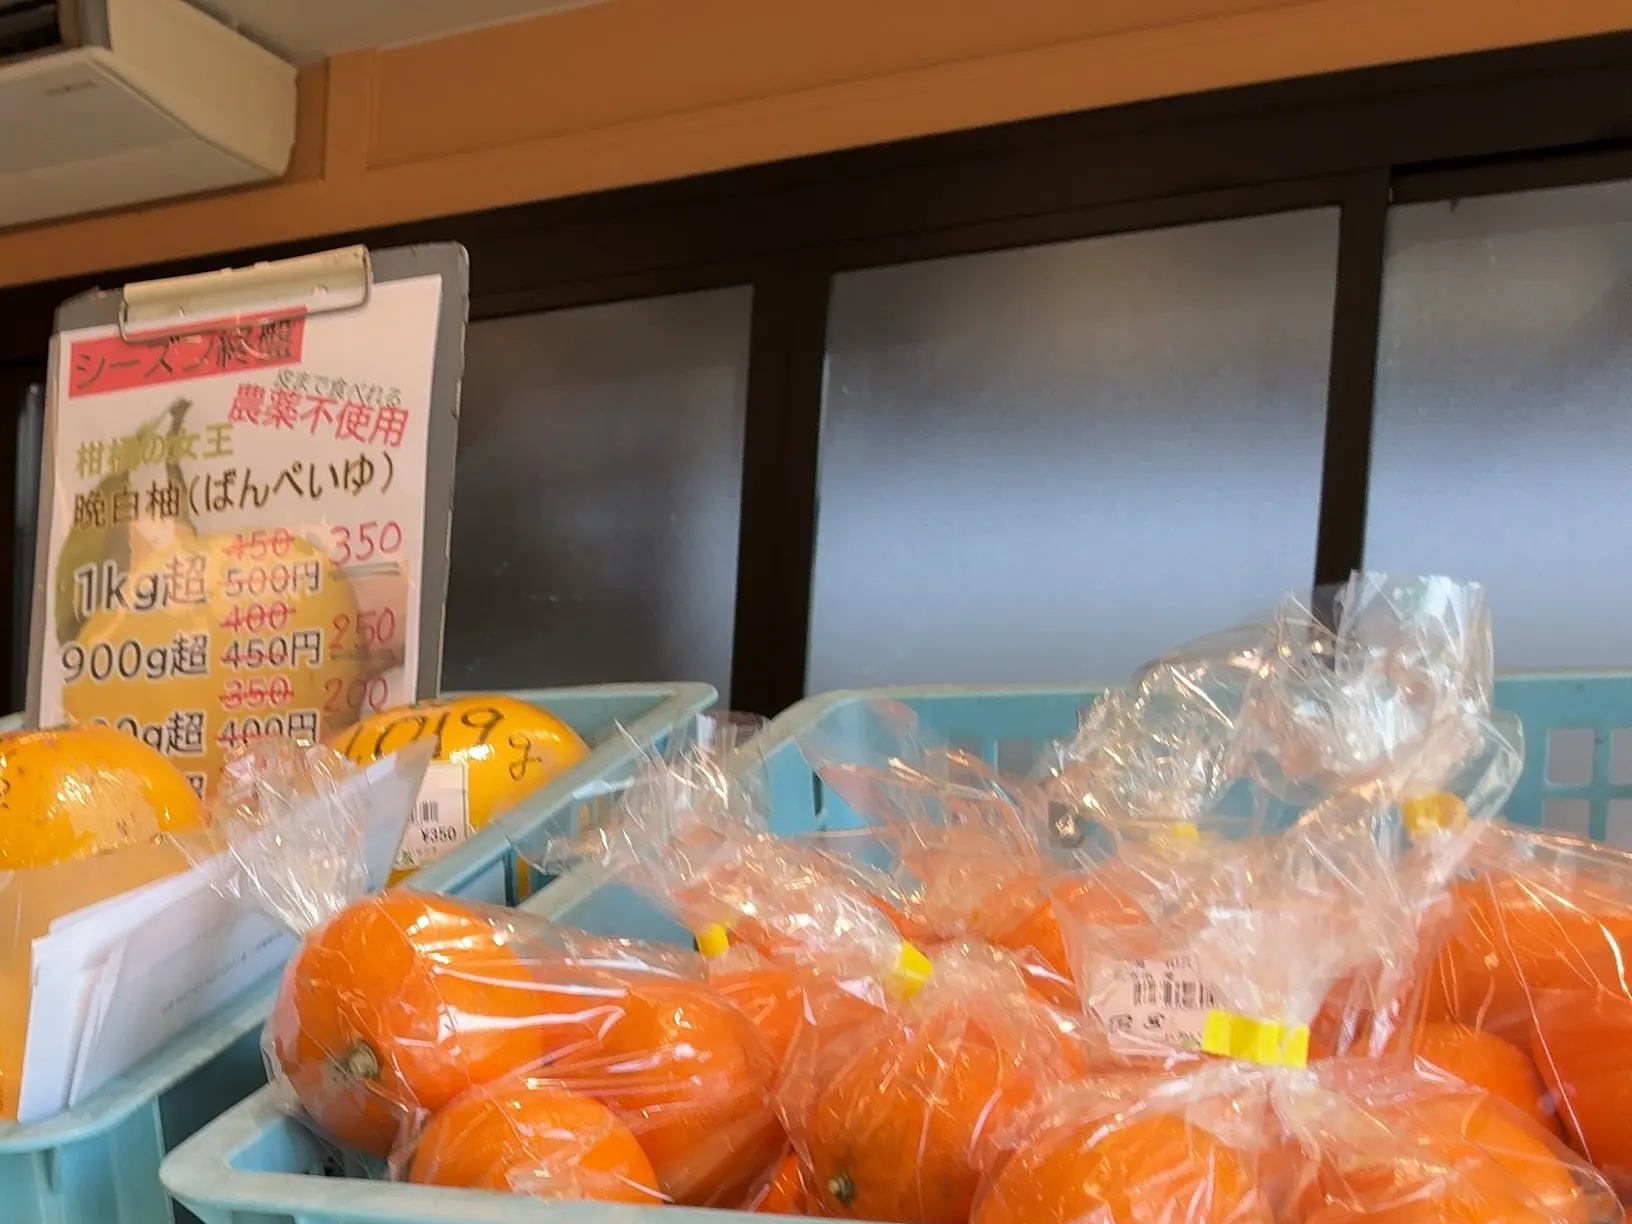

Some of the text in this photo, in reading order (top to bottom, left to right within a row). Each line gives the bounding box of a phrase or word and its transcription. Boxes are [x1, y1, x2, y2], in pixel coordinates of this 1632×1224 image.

[228, 382, 409, 448] 農薬不使用
[329, 520, 403, 567] 350
[73, 555, 208, 614] 1kg超
[328, 606, 397, 652] 250
[61, 630, 322, 683] 900g超 450円
[323, 676, 389, 713] 200
[216, 711, 320, 752] 400円
[419, 824, 458, 846] ¥350
